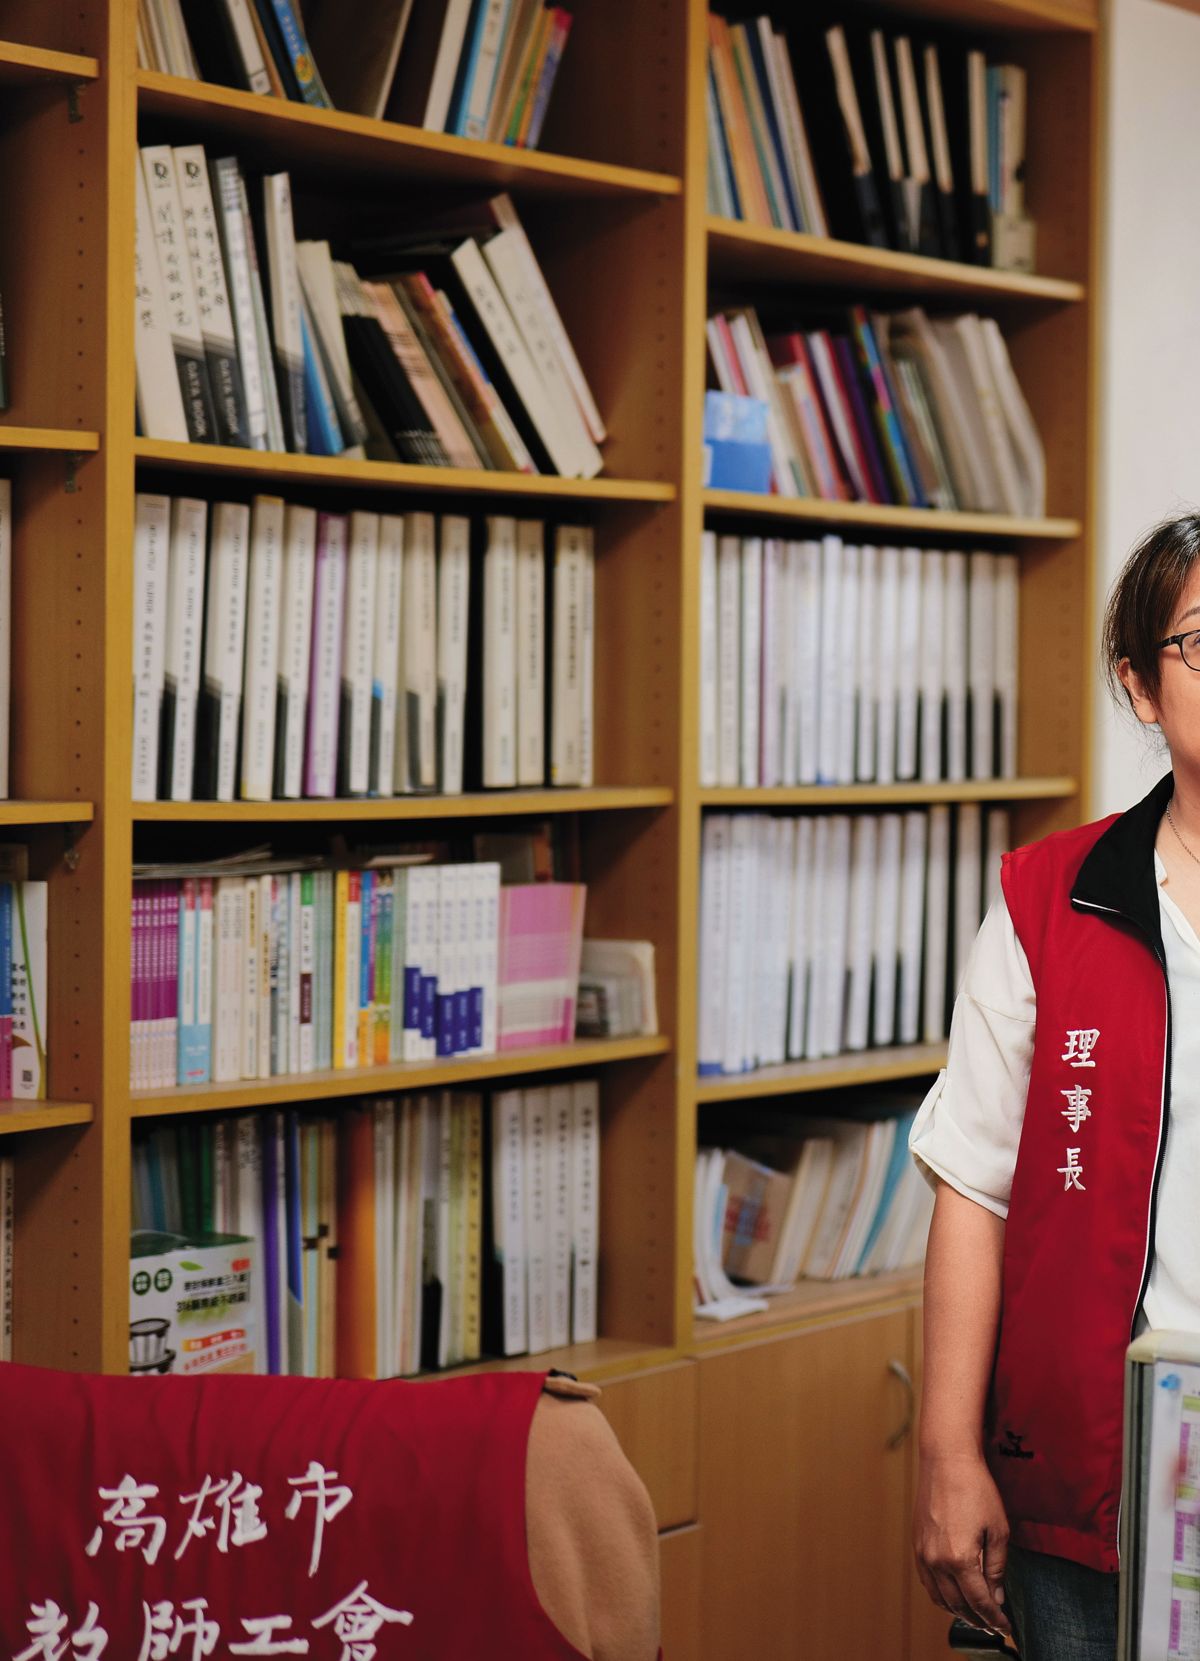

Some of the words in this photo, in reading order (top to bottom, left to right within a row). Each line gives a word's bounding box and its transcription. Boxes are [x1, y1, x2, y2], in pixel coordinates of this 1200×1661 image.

[1056, 1028, 1100, 1192] 理事長
[86, 1460, 353, 1577] 高雄市
[12, 1580, 414, 1661] 教師工會
